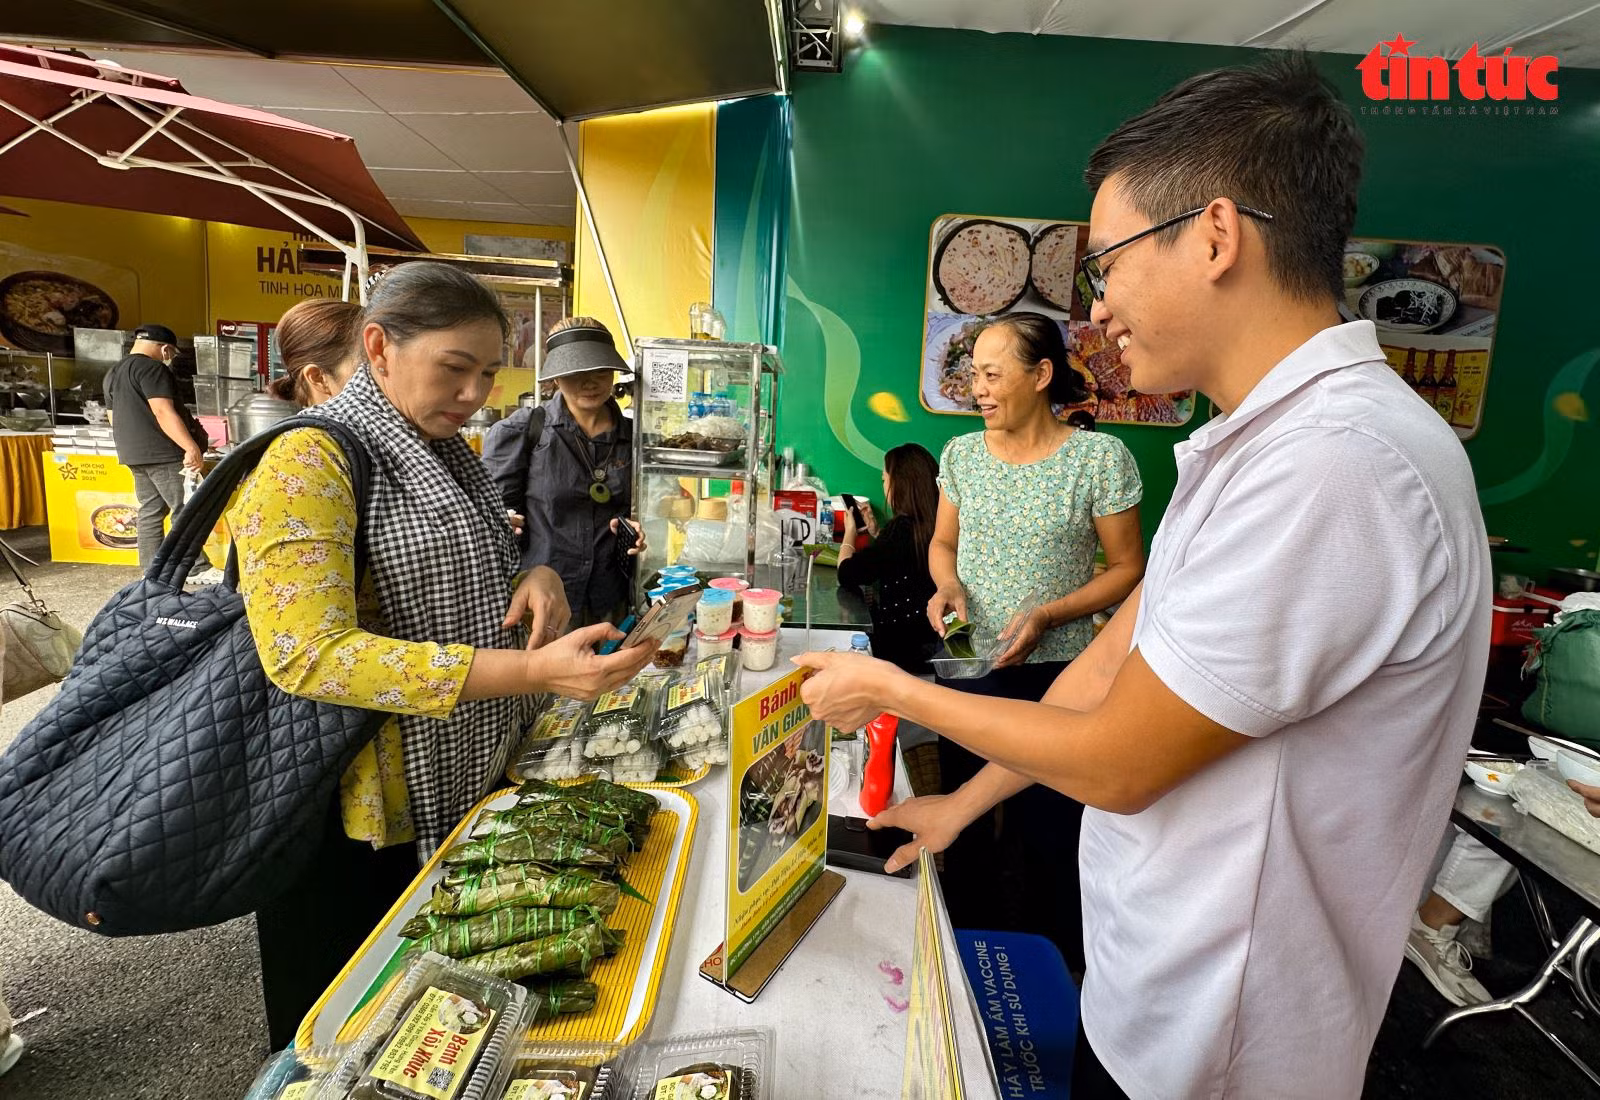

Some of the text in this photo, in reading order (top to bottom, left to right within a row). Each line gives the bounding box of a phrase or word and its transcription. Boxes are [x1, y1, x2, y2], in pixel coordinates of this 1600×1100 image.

[259, 281, 359, 299] TINH HOA MIN
[168, 618, 198, 628] WALLACE
[760, 681, 797, 721] Bánh
[753, 704, 810, 755] VĂN GIAN
[975, 940, 998, 996] VACCINE
[996, 952, 1016, 989] DỤNG
[1002, 992, 1022, 1010] SỬ
[1012, 1014, 1030, 1036] KHI
[403, 1028, 447, 1079] Xôi Khúc
[439, 1034, 468, 1065] Bánh
[994, 1027, 1014, 1057] LÀM
[1003, 1064, 1024, 1098] HÃY
